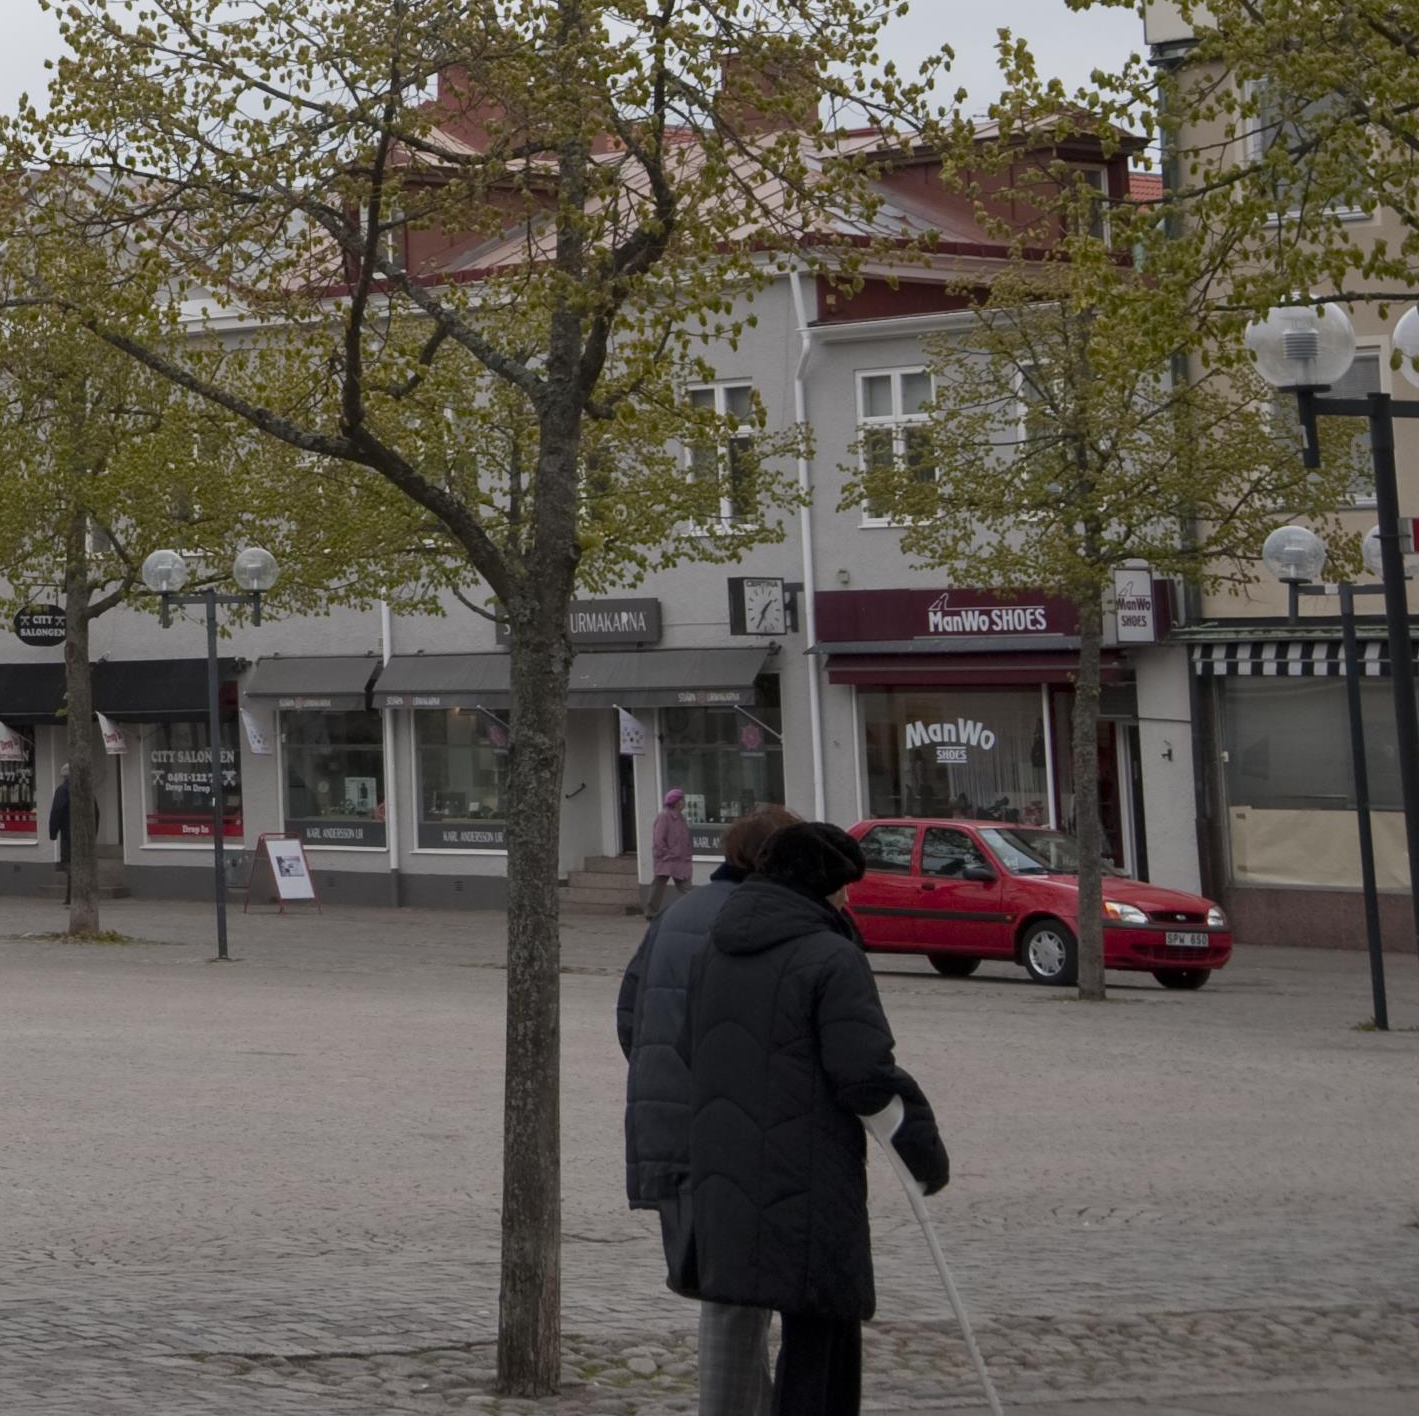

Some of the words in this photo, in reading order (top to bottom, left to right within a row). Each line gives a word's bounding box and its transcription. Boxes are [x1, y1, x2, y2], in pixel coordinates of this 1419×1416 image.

[570, 611, 647, 633] URMAKARNA
[928, 609, 988, 633] ManWo
[991, 608, 1047, 631] SHOES
[1121, 615, 1147, 627] SHOES
[905, 718, 995, 750] ManWo
[151, 750, 174, 763] CITY
[177, 749, 235, 764] SALONEN
[936, 750, 967, 760] SHOES
